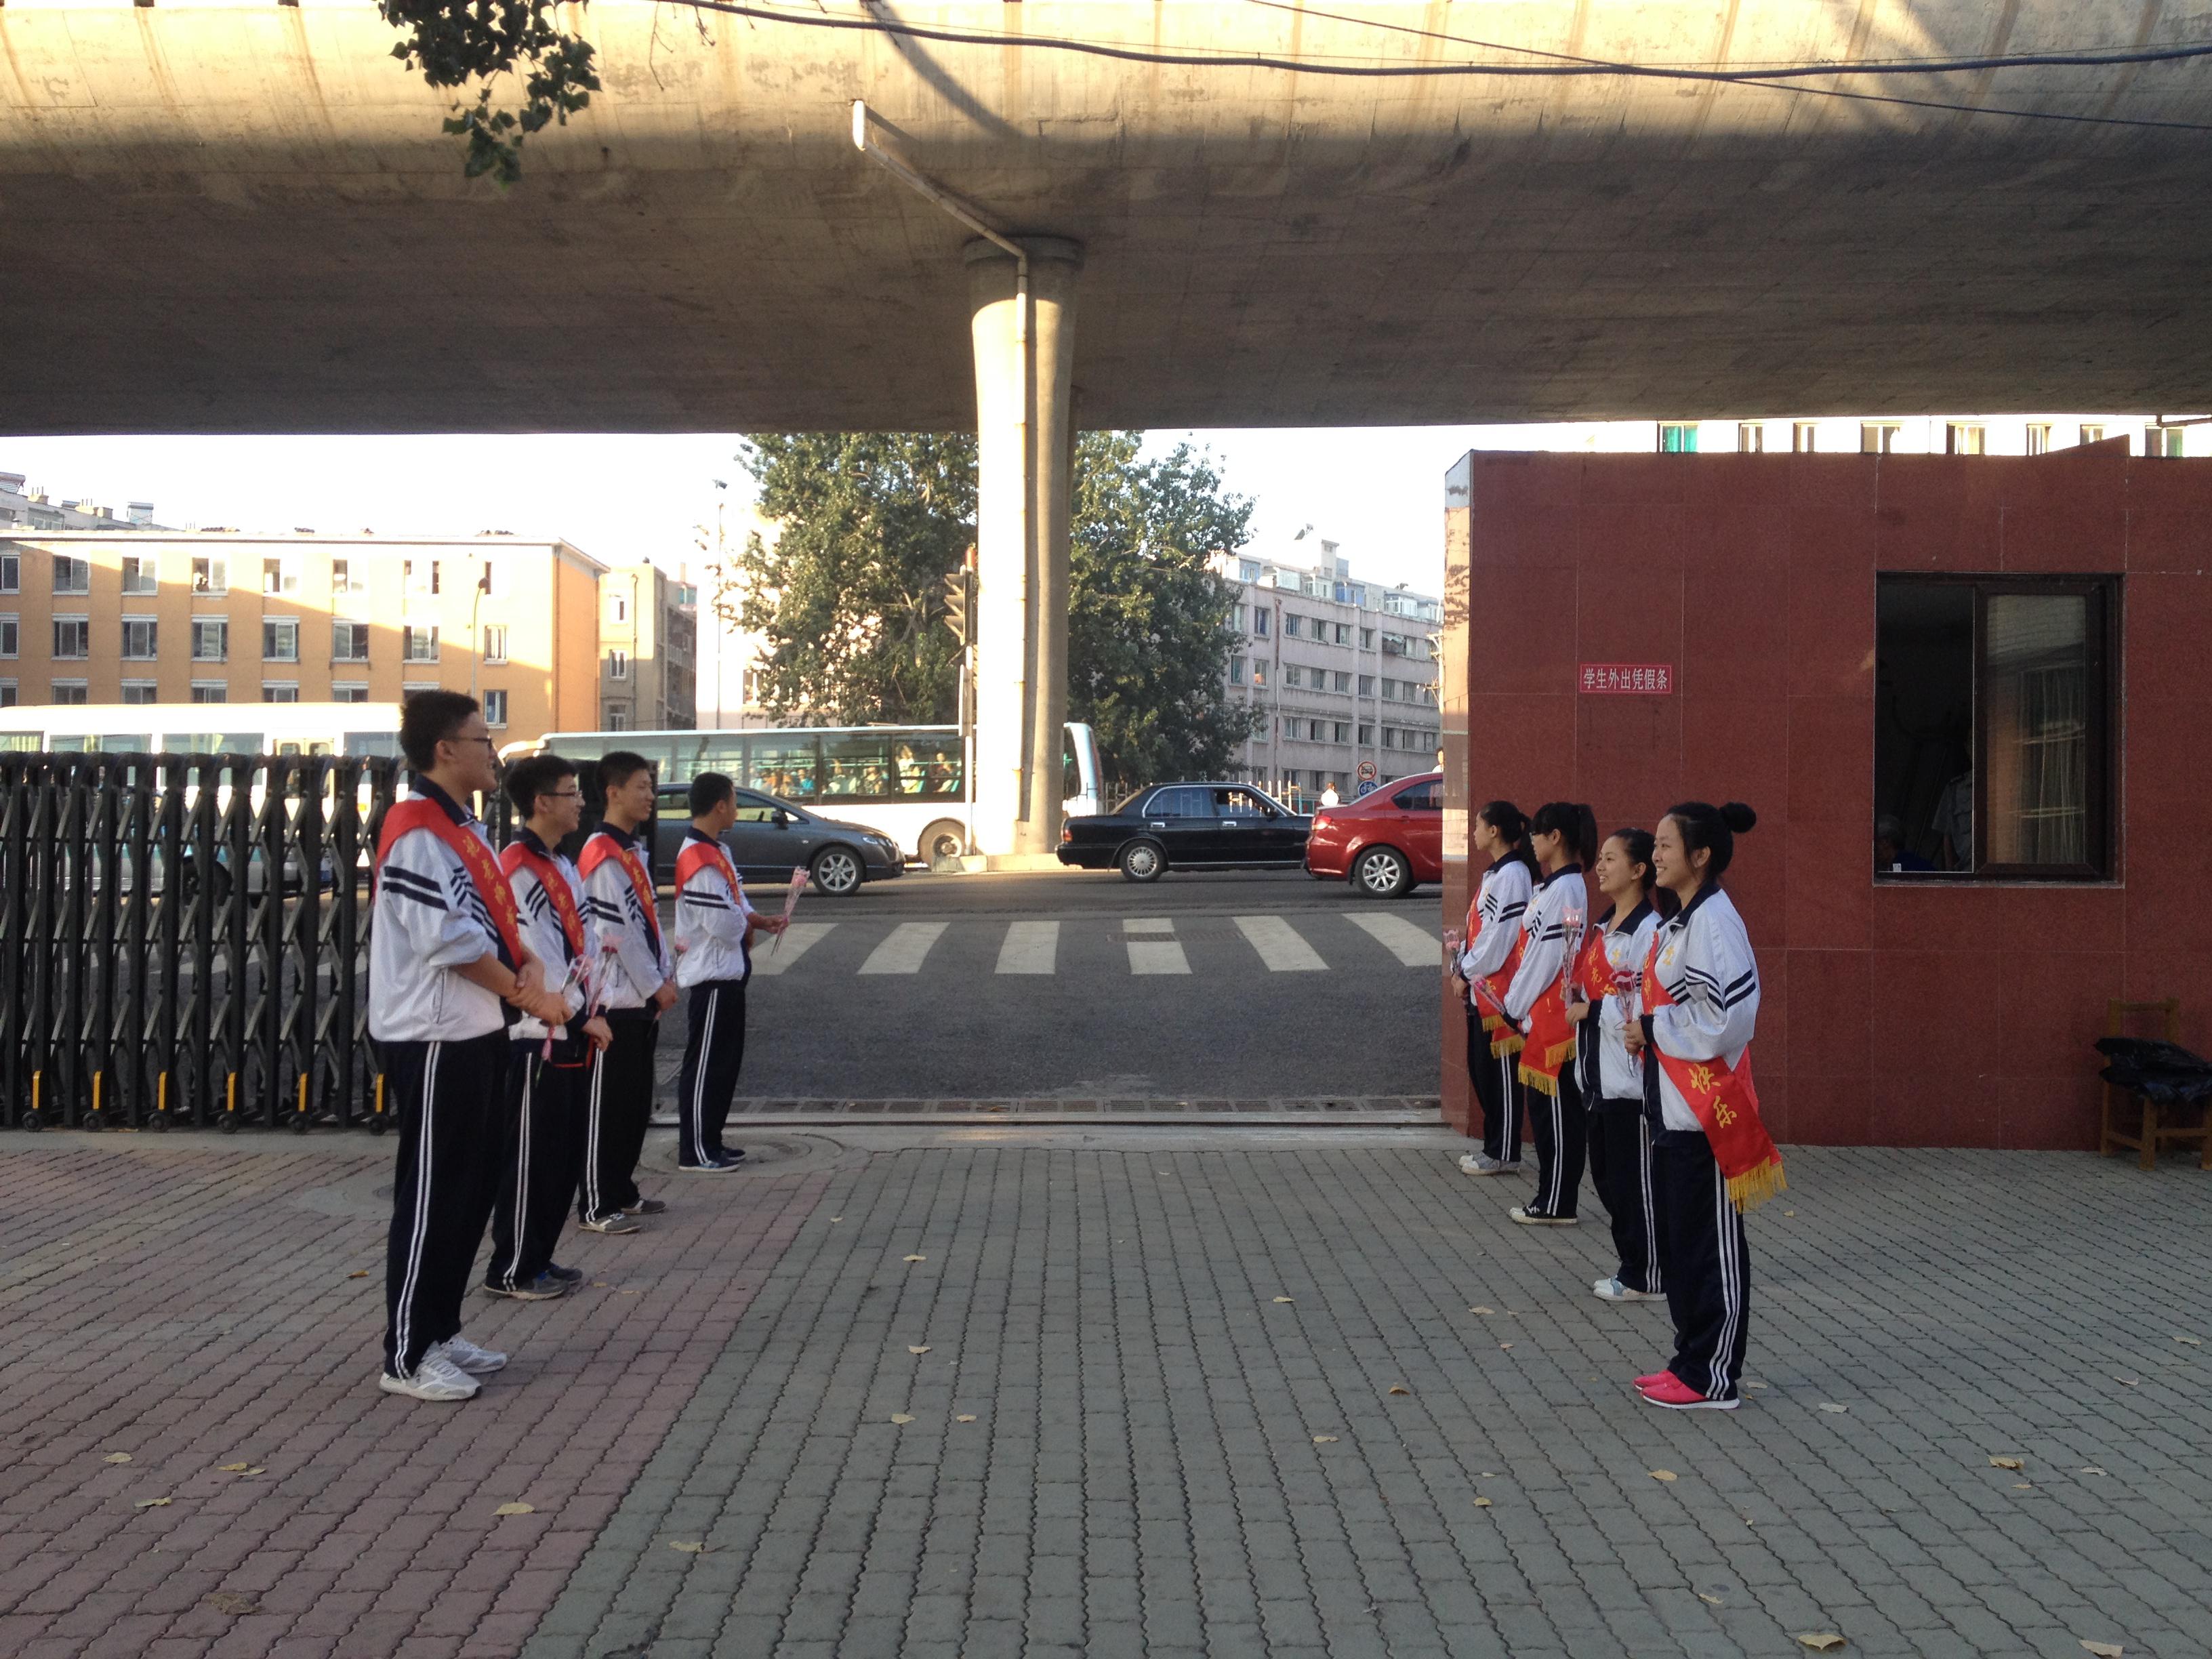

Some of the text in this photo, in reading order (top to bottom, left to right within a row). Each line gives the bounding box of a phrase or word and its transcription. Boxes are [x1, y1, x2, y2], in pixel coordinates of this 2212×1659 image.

[1584, 668, 1667, 690] 学生外出凭假条
[1688, 1063, 1737, 1128] 快乐
